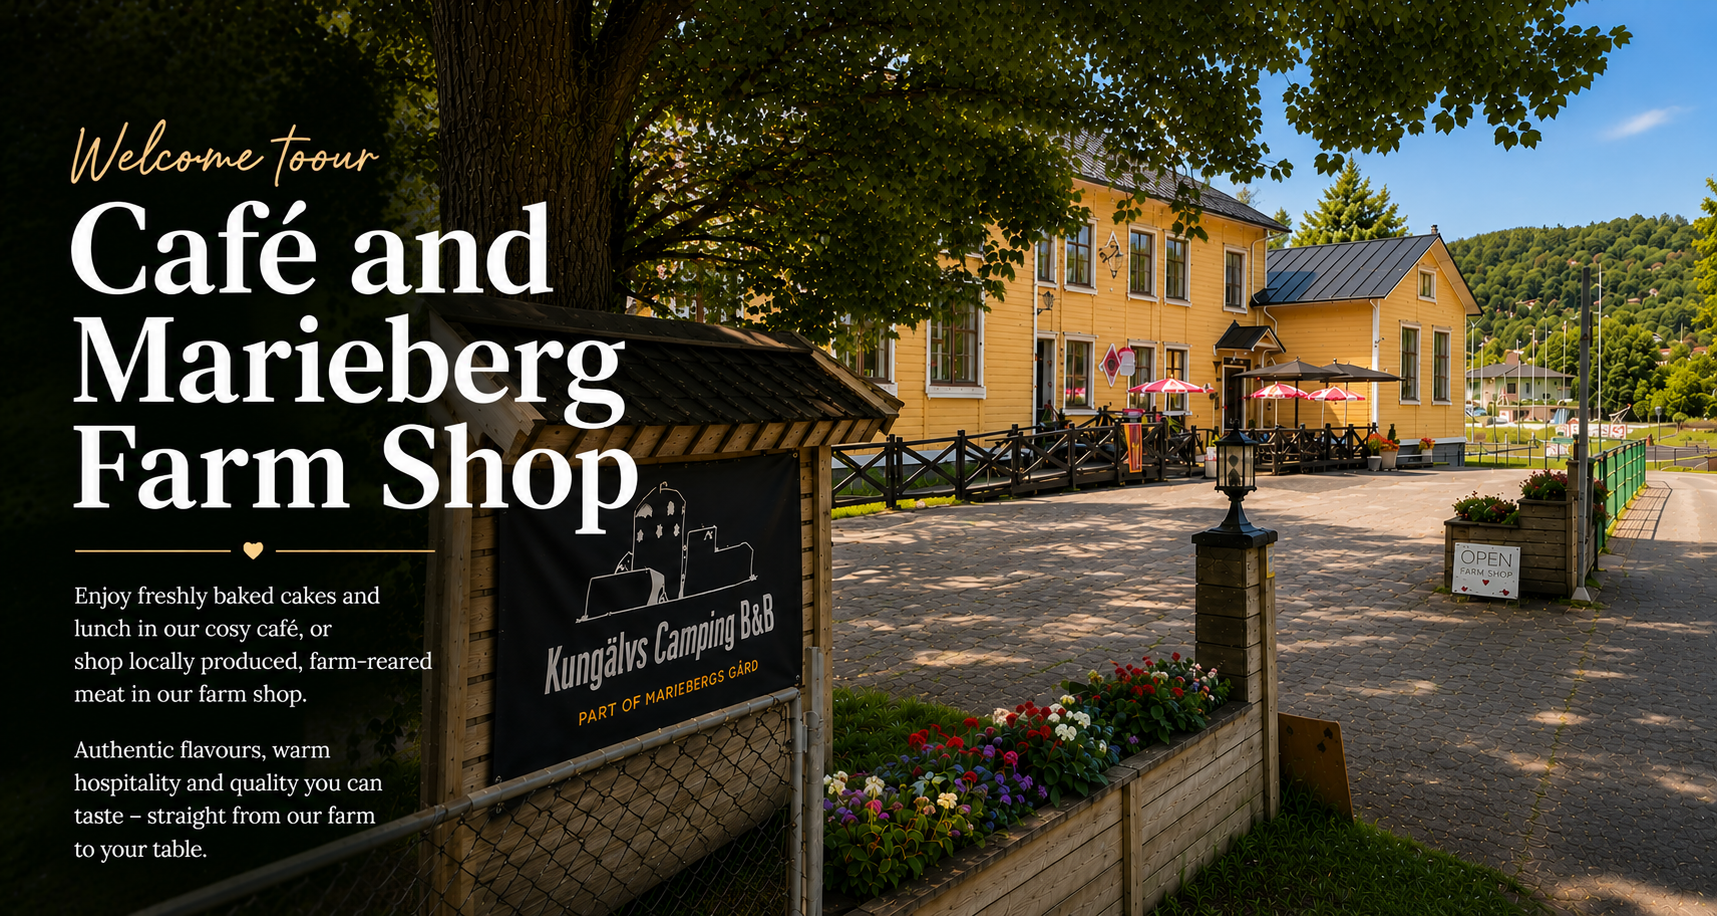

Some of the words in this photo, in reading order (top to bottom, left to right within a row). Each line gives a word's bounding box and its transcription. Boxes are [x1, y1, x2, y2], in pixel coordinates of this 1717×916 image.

[1459, 567, 1485, 577] FARM
[1487, 569, 1513, 579] SHOP
[1460, 549, 1512, 568] OPEN
[543, 630, 649, 696] Kungälvs
[653, 609, 736, 665] Camping
[738, 592, 775, 641] B&B
[577, 701, 618, 727] PART
[620, 693, 642, 713] OF
[644, 668, 725, 707] MARIEBERGS
[727, 658, 759, 679] GÅRD
